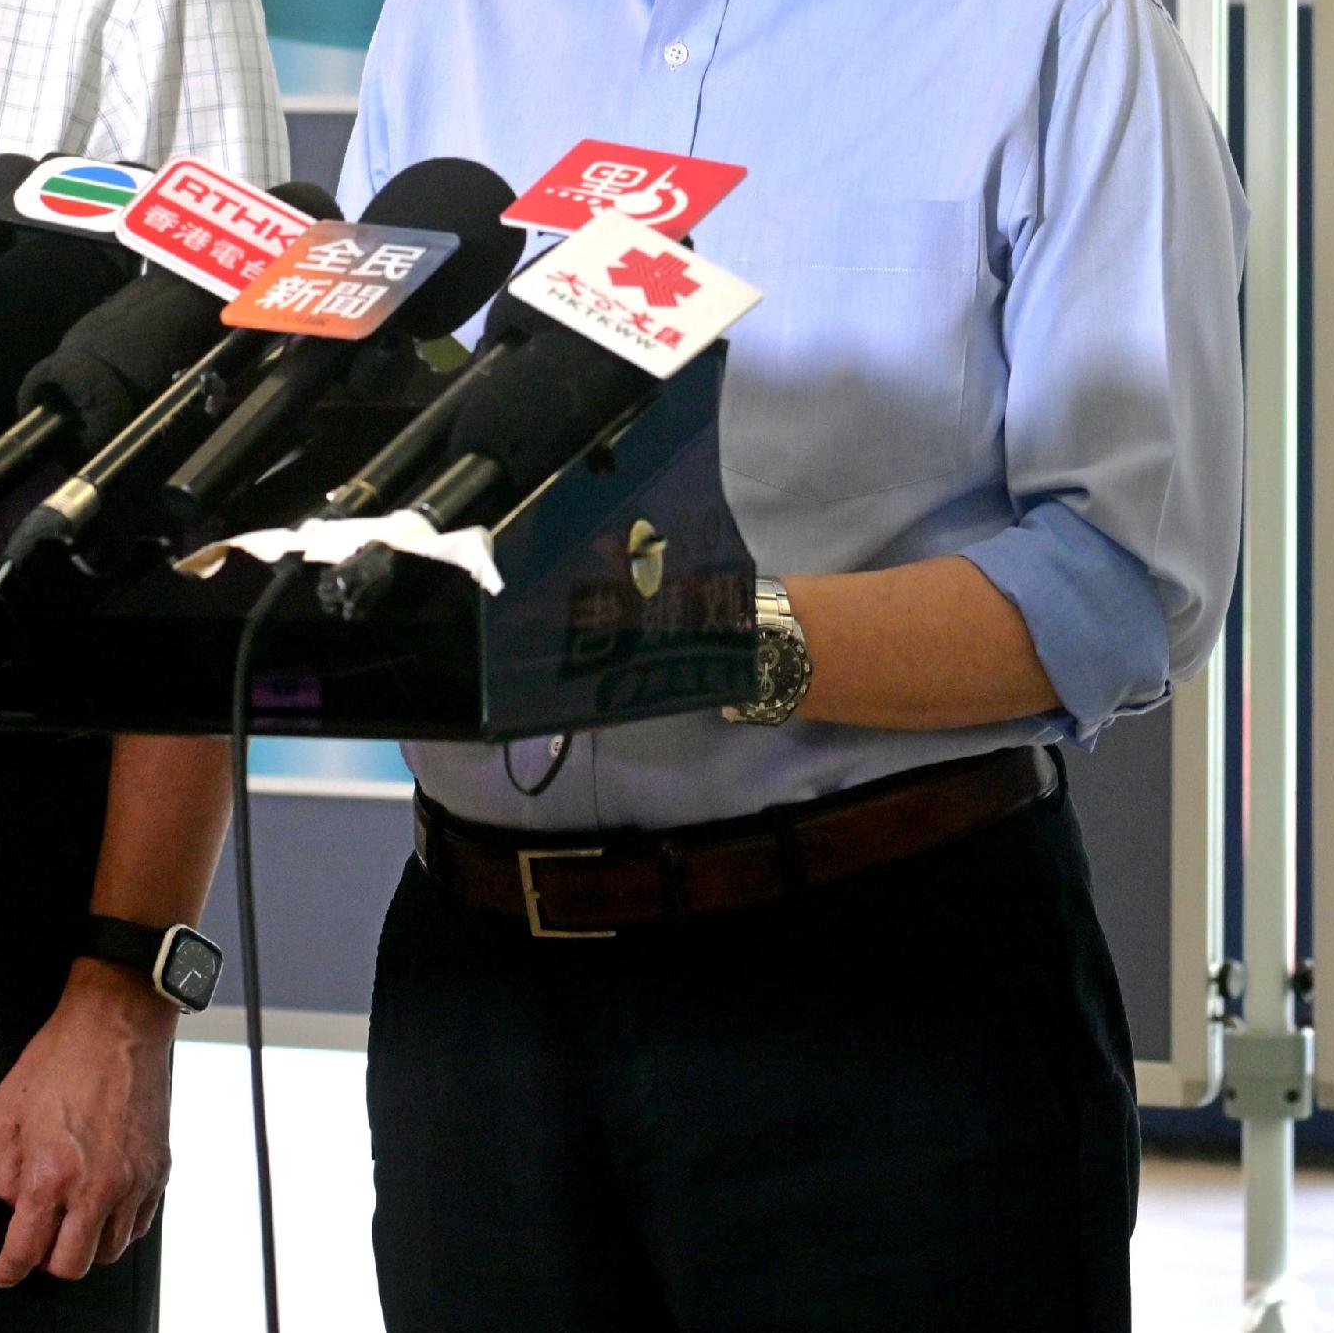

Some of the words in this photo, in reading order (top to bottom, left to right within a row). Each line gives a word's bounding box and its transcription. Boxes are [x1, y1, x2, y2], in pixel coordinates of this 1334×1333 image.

[172, 174, 302, 251] RTHK
[142, 204, 269, 284] 香港電台
[294, 237, 427, 282] 全民
[254, 275, 390, 320] 新聞
[547, 287, 657, 349] HKTKWW
